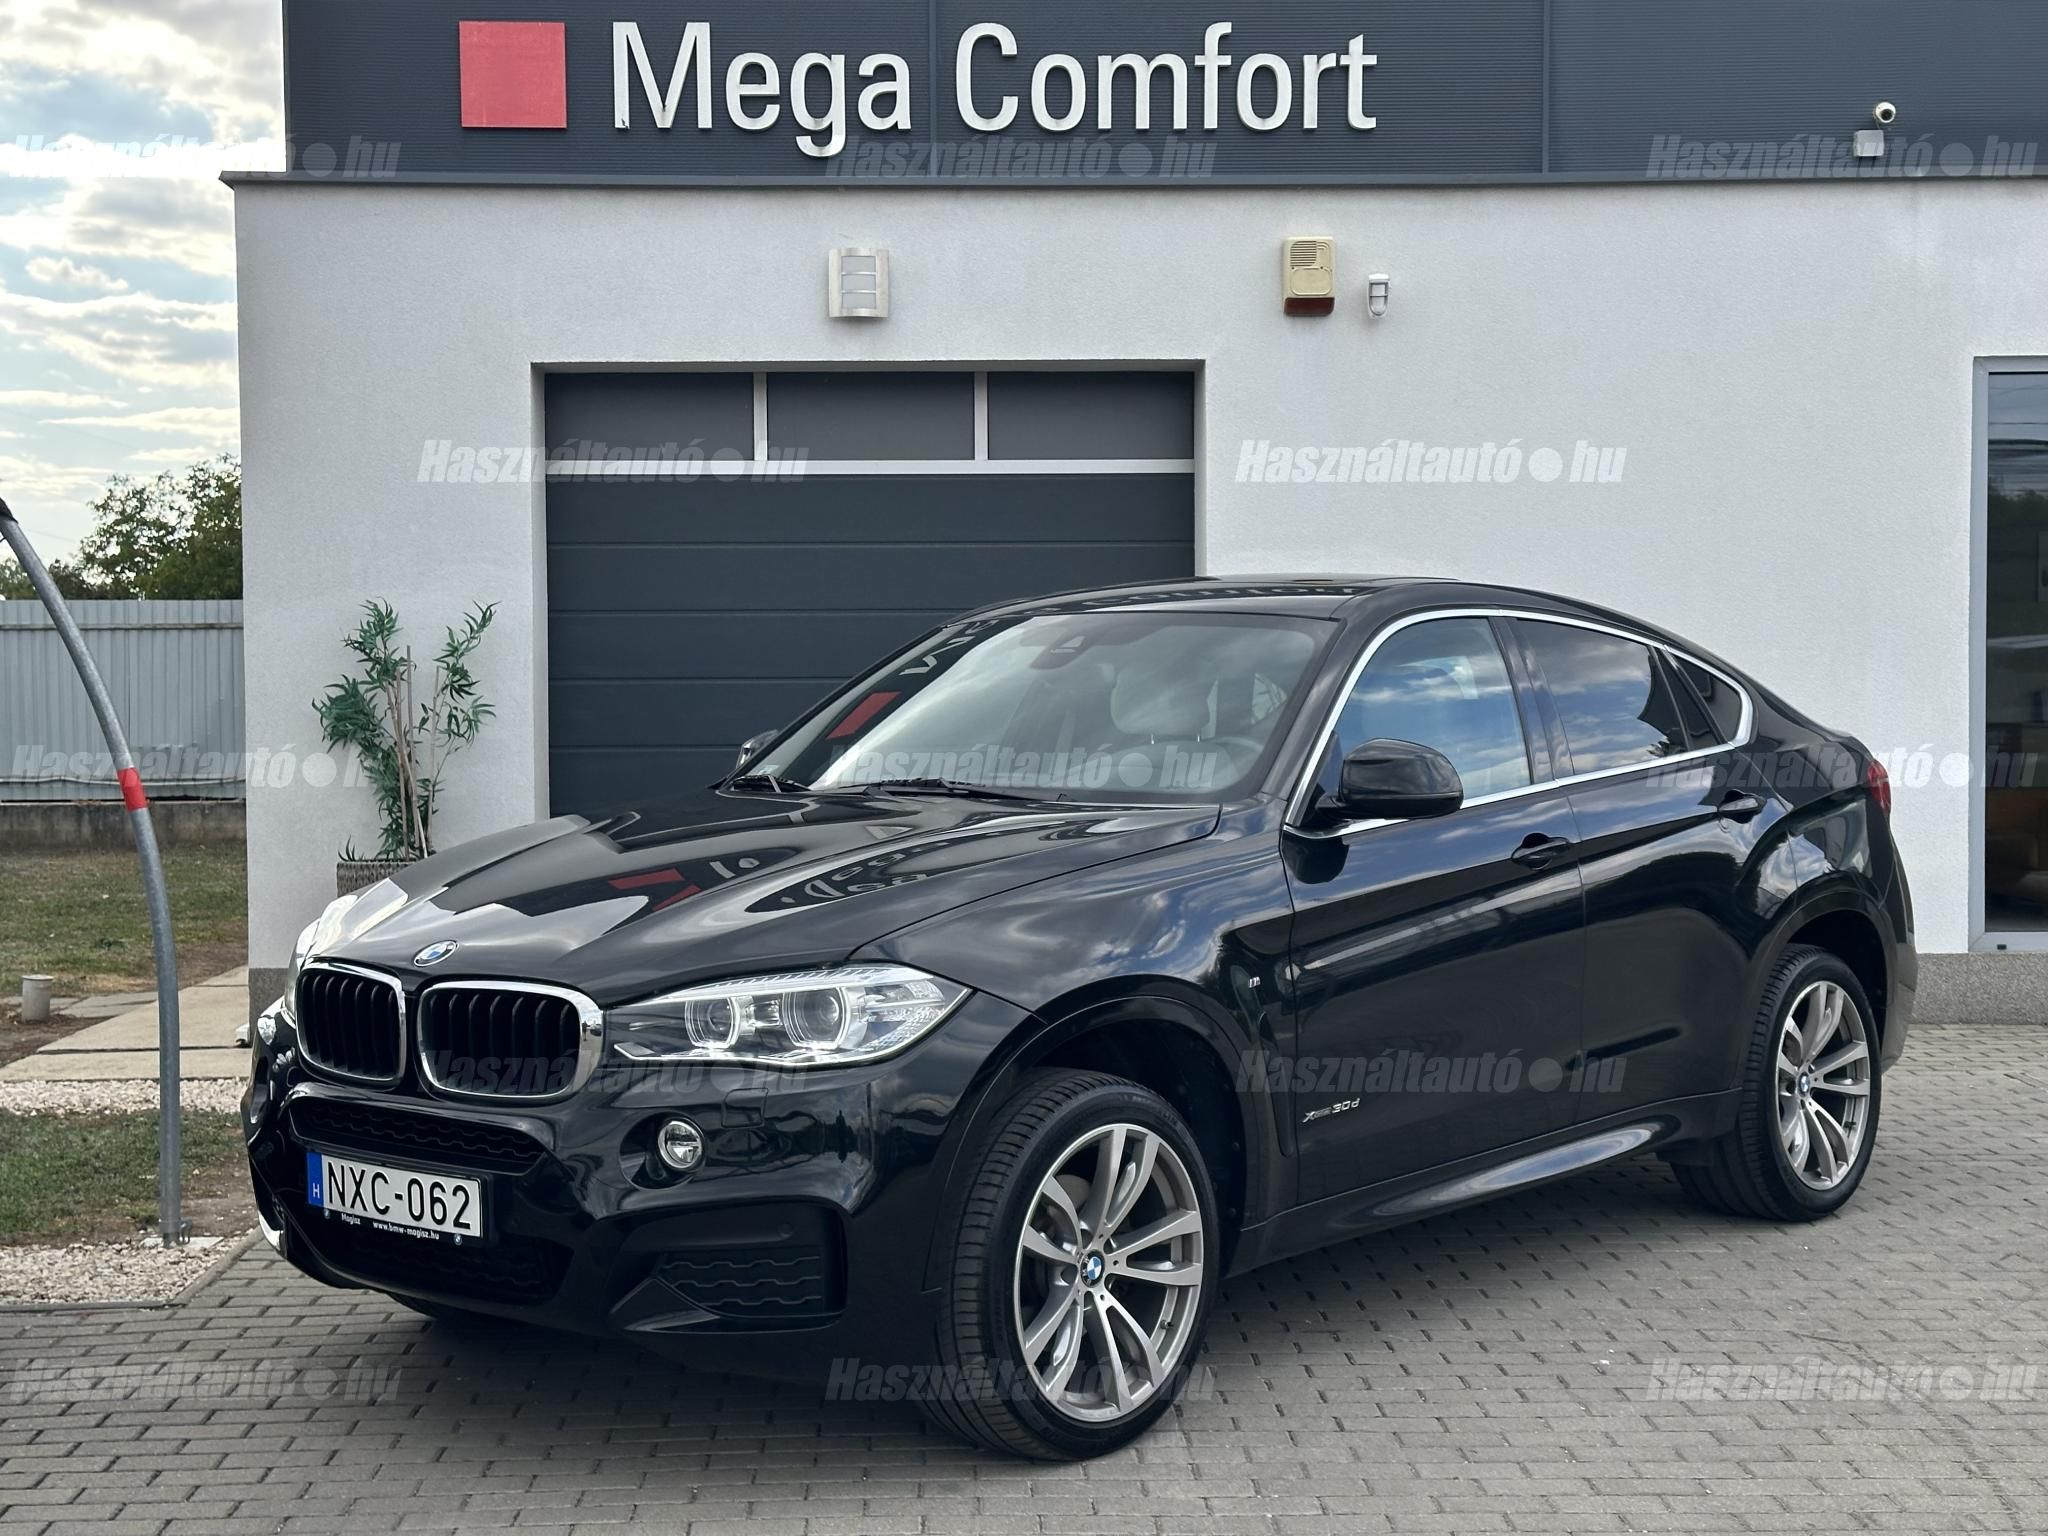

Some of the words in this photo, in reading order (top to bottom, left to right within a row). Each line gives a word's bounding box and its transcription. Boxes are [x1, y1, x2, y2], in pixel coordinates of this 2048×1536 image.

[612, 21, 912, 158] Mega
[955, 21, 1378, 132] Comfort
[312, 1182, 320, 1199] H
[327, 1161, 471, 1230] NXC-062
